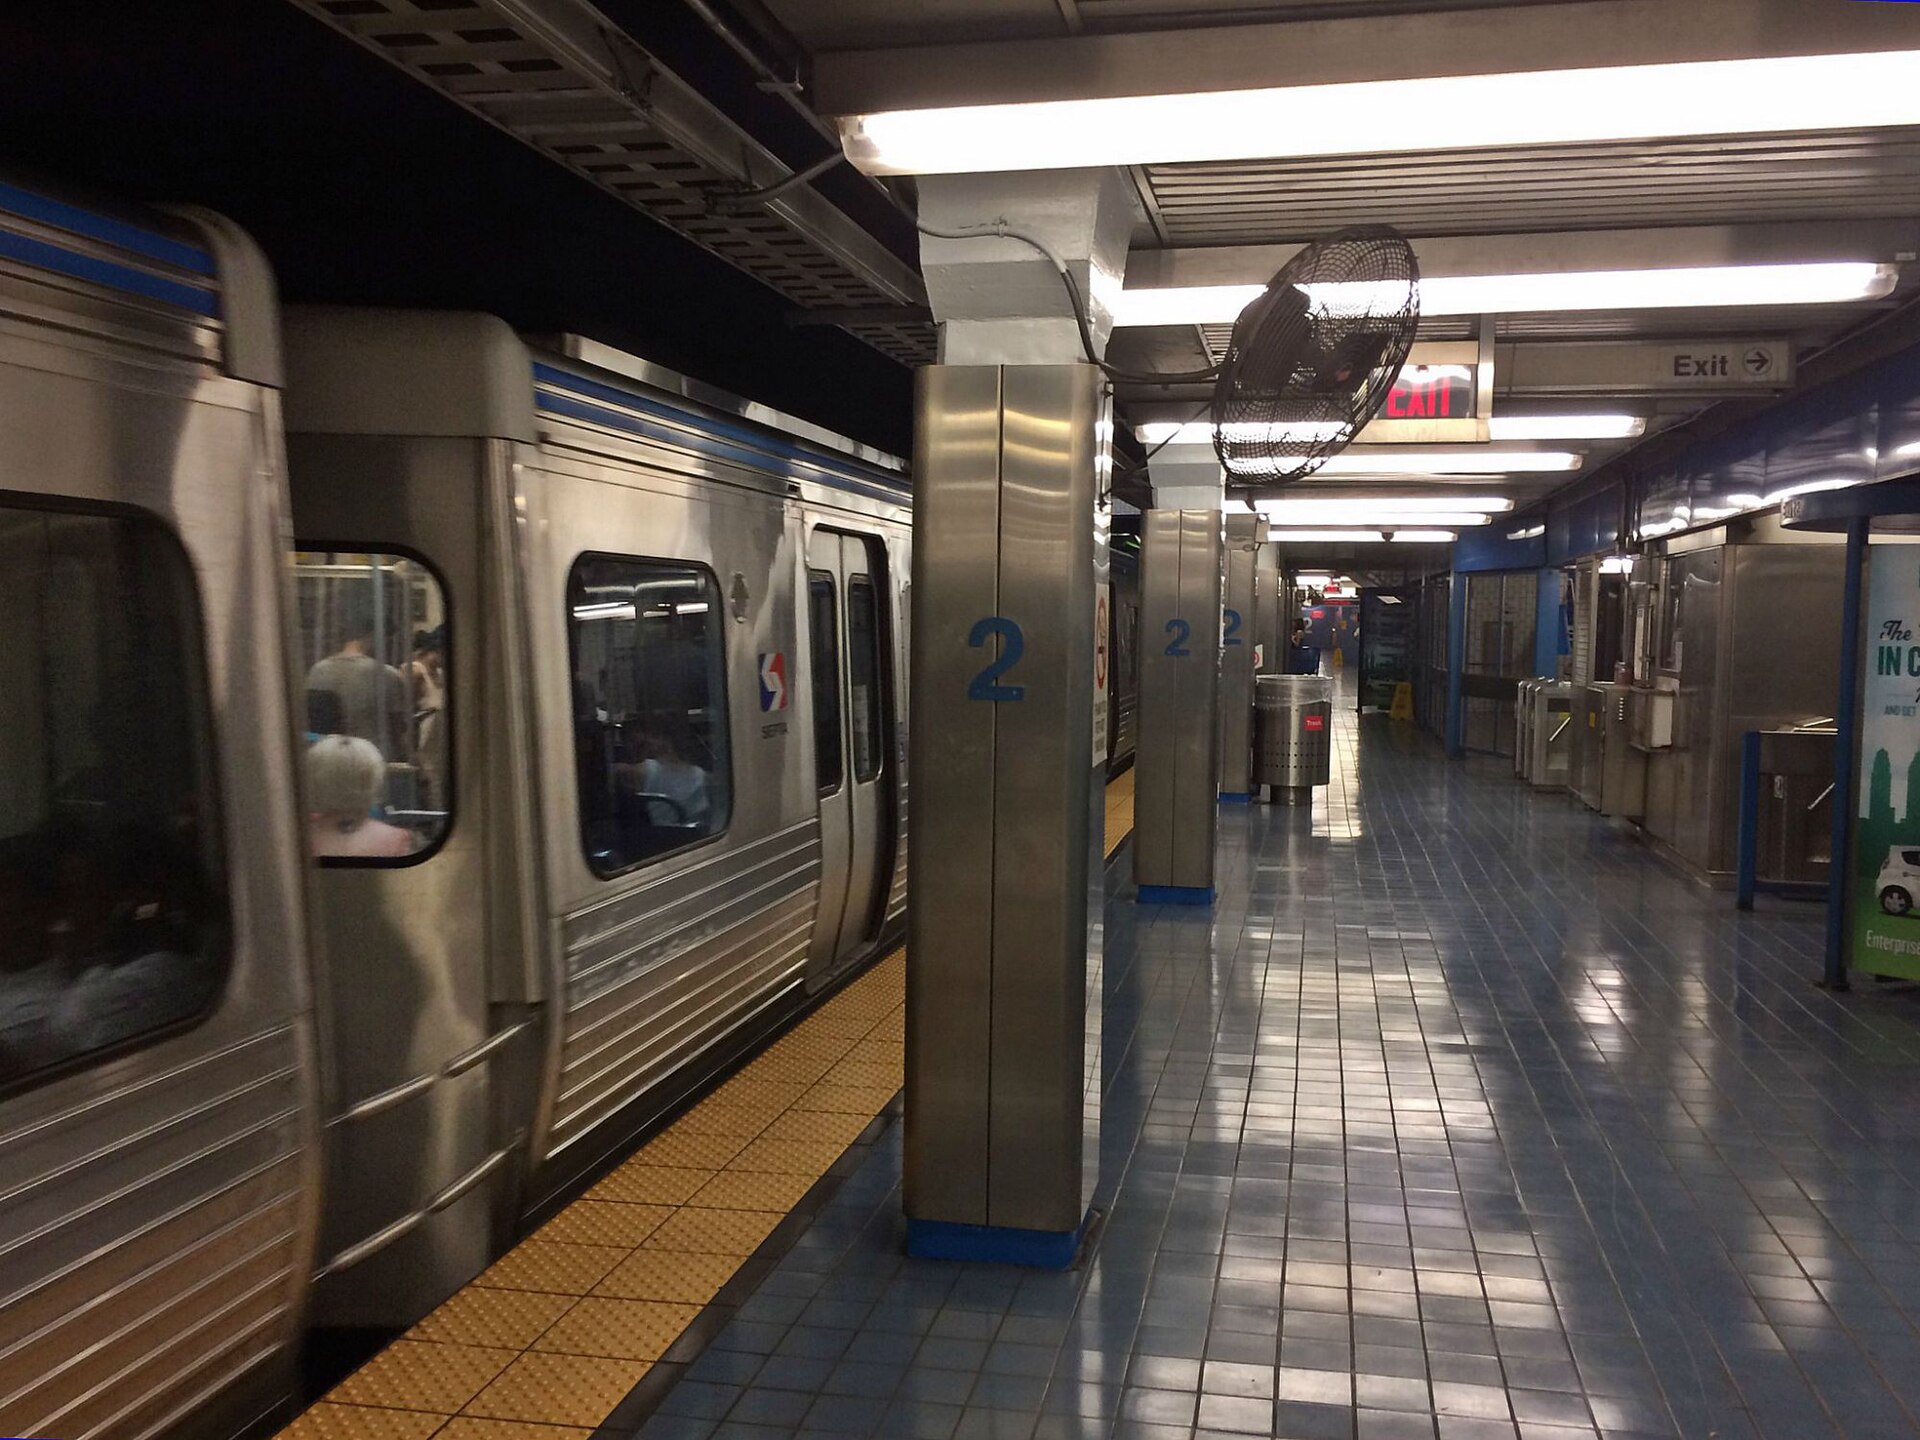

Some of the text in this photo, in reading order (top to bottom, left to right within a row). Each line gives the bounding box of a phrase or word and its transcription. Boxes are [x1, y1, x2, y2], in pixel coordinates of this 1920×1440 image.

[1673, 354, 1729, 377] Exit
[1386, 377, 1452, 418] EXIT
[1165, 619, 1191, 656] 2
[1223, 609, 1242, 645] 2
[1303, 614, 1313, 634] 2
[1880, 620, 1912, 642] The
[967, 615, 1025, 702] 2
[1878, 646, 1902, 677] IN
[1306, 720, 1322, 728] Trash
